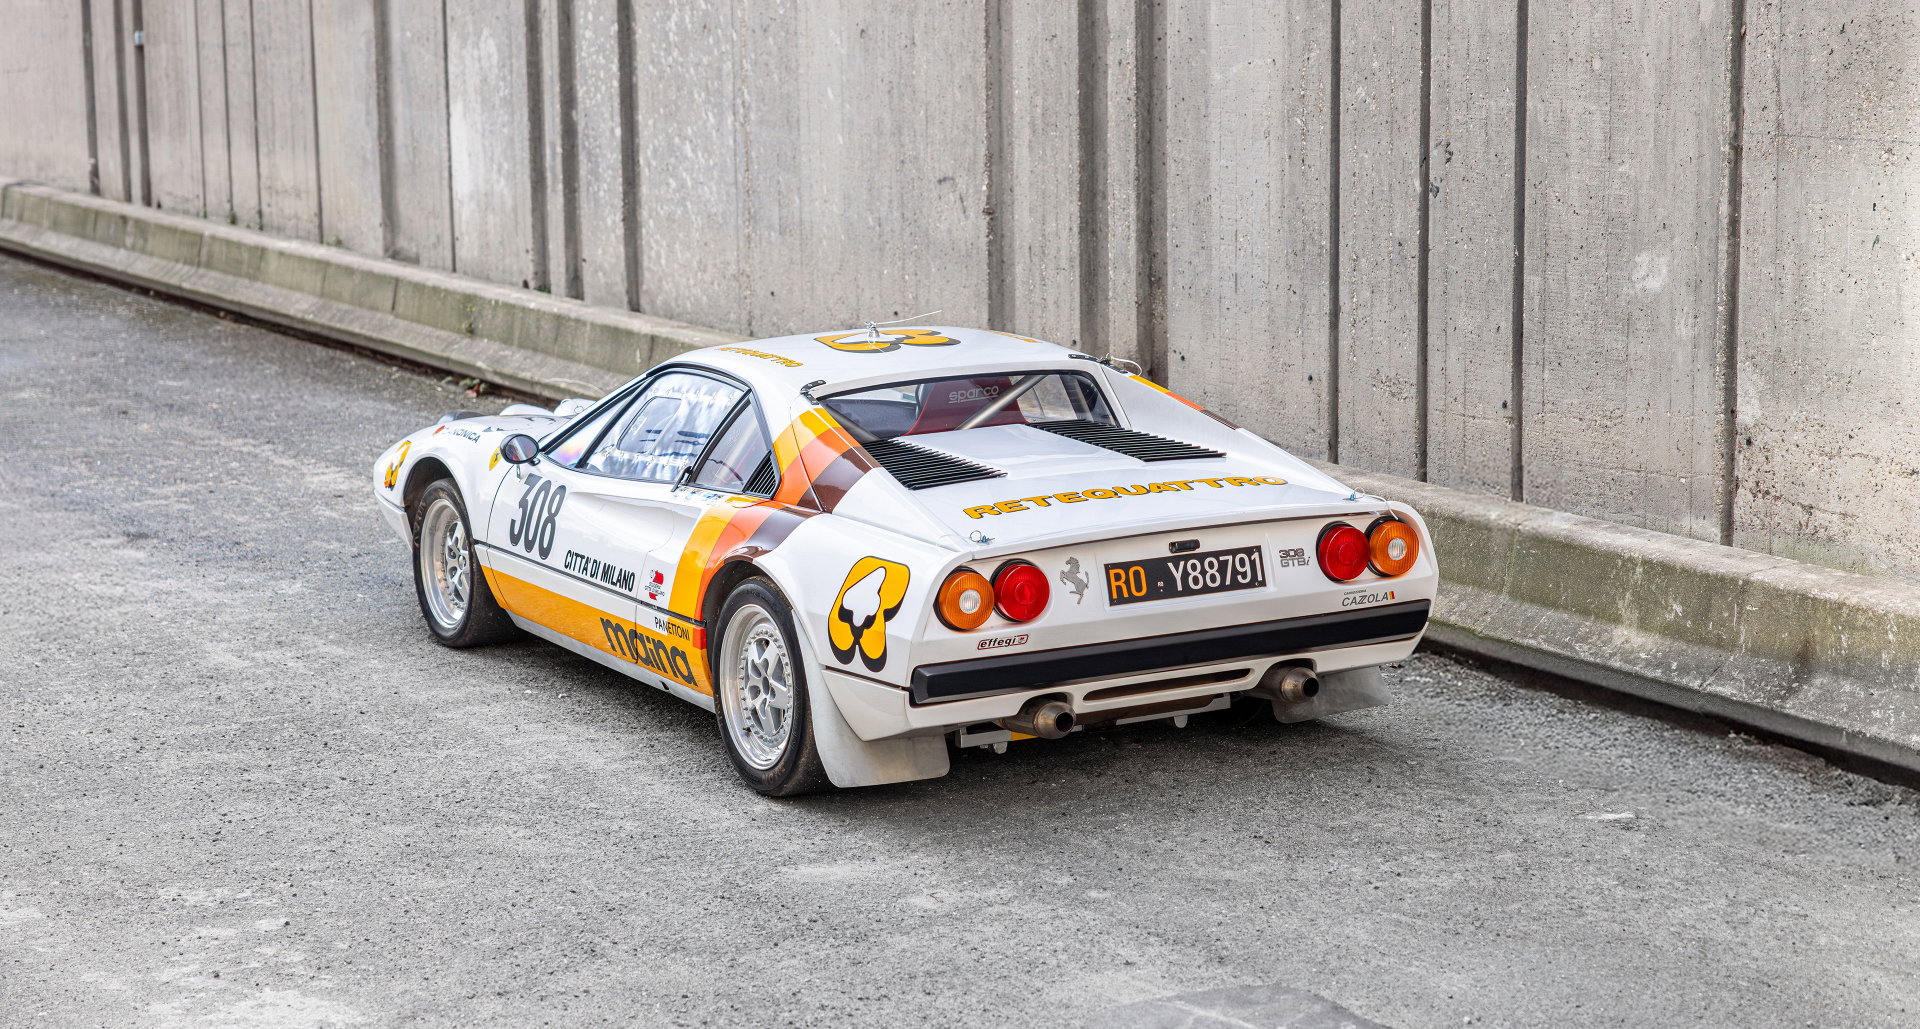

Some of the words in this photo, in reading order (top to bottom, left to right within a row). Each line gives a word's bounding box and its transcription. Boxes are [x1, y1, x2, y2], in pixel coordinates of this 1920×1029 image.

[949, 385, 999, 403] sparco
[962, 475, 1289, 519] RETEQUATTRO
[509, 472, 567, 560] 308
[1279, 548, 1304, 558] 308
[590, 557, 601, 580] DI
[600, 562, 636, 592] MILANO
[1108, 565, 1147, 600] RO
[1167, 552, 1263, 592] Y88791
[1341, 591, 1389, 607] CAZZOLA
[654, 616, 690, 641] PANETTONI
[980, 635, 1017, 648] effegi
[599, 616, 699, 687] maina
